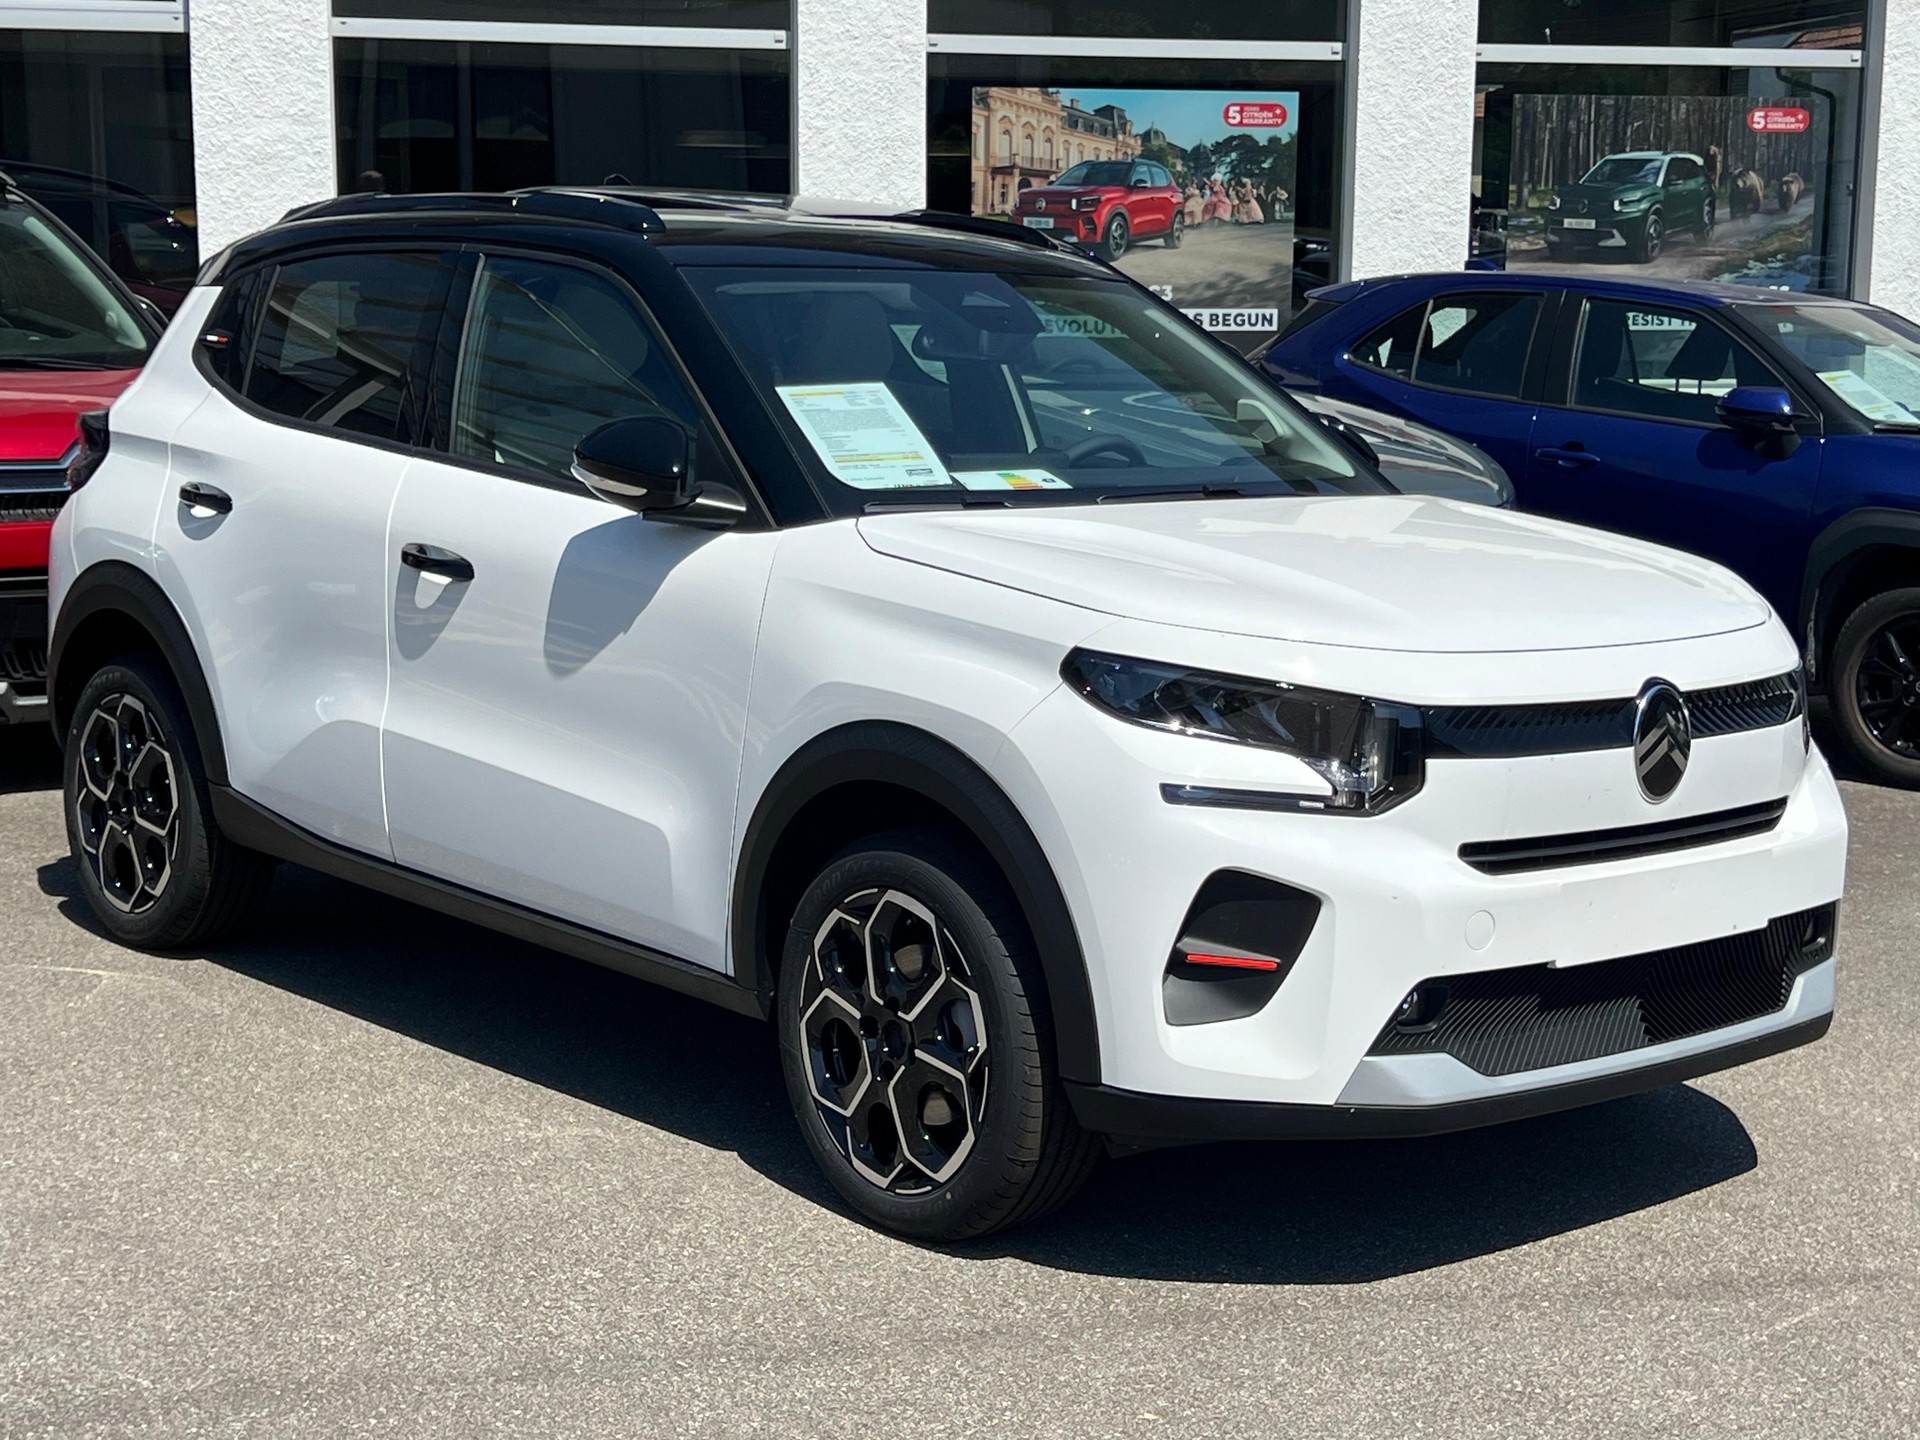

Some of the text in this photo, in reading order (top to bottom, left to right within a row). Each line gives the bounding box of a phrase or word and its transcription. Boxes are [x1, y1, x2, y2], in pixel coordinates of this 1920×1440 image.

[1228, 106, 1241, 124] 5
[1752, 111, 1765, 129] 5
[1209, 312, 1274, 328] BEGUN
